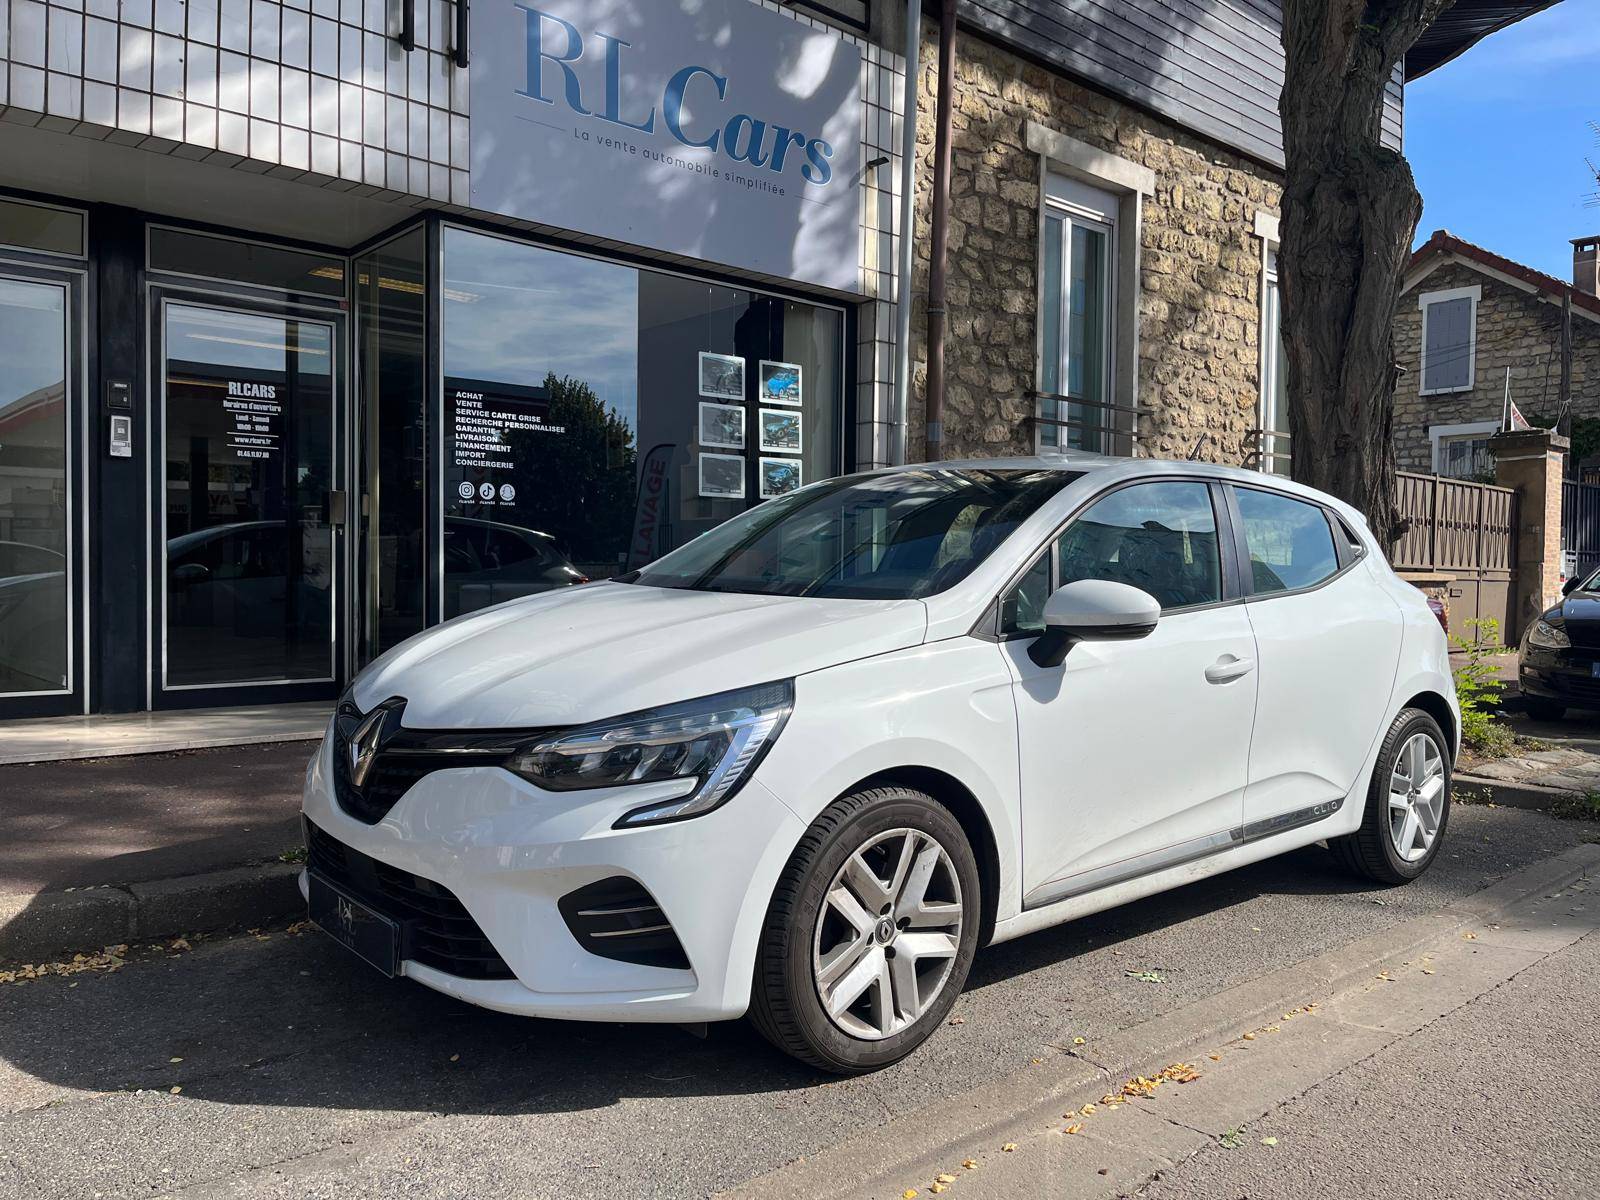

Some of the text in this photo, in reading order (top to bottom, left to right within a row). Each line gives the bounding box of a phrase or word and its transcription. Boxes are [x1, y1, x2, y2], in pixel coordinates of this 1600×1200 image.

[573, 127, 785, 197] La vente automobile simplifiée
[228, 381, 276, 398] RLCARS
[456, 391, 483, 400] ACHAT
[223, 400, 248, 409] Horaires
[456, 400, 482, 408] VENTE
[456, 408, 541, 423] SERVICE CARTE GRISE
[456, 416, 503, 427] RECHERCHE
[456, 425, 496, 434] GARANTIE
[456, 433, 498, 442] LIVRAISON
[456, 441, 511, 452] FINANCEMENT
[456, 450, 486, 459] IMPORT
[456, 459, 514, 468] CONCIERGERIE
[636, 458, 665, 556] LAVAGE
[1313, 802, 1337, 814] CLIO
